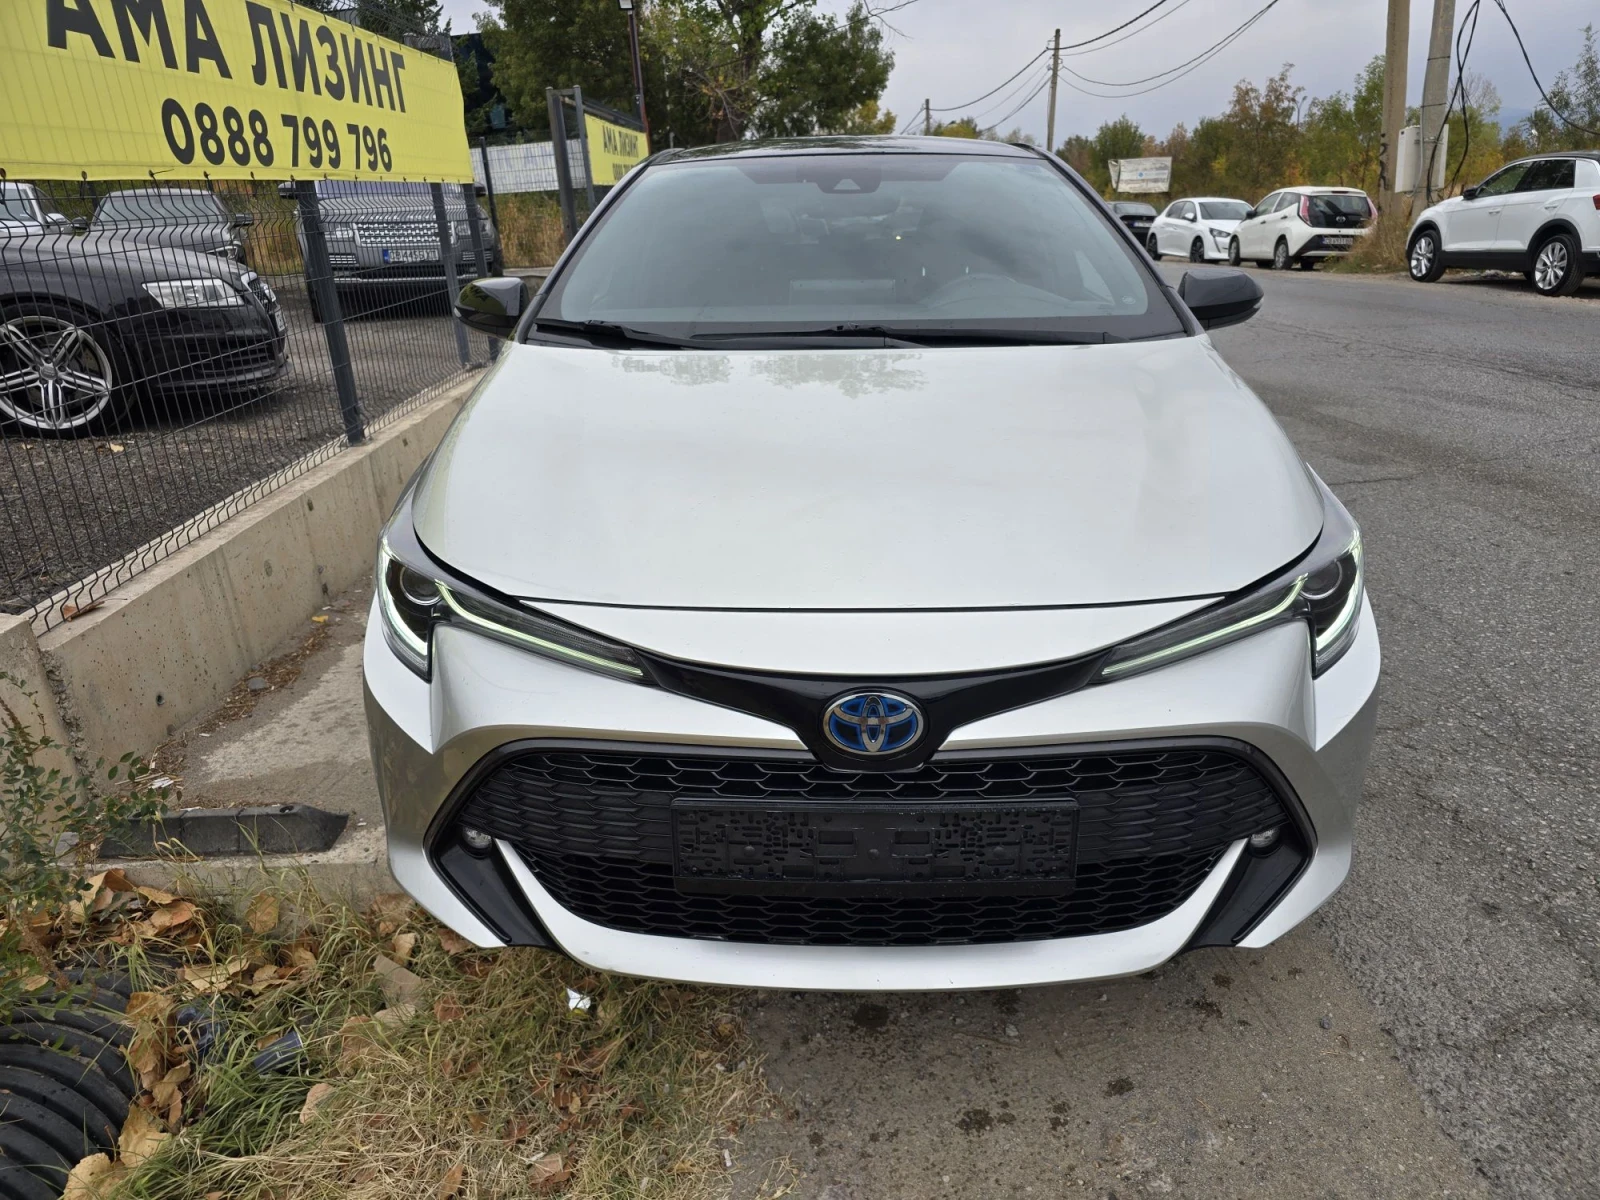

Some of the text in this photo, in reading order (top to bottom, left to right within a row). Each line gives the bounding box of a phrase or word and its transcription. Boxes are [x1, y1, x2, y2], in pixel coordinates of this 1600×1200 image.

[245, 0, 406, 113] ЛИЗИНГ
[161, 97, 393, 172] 0888 799 796
